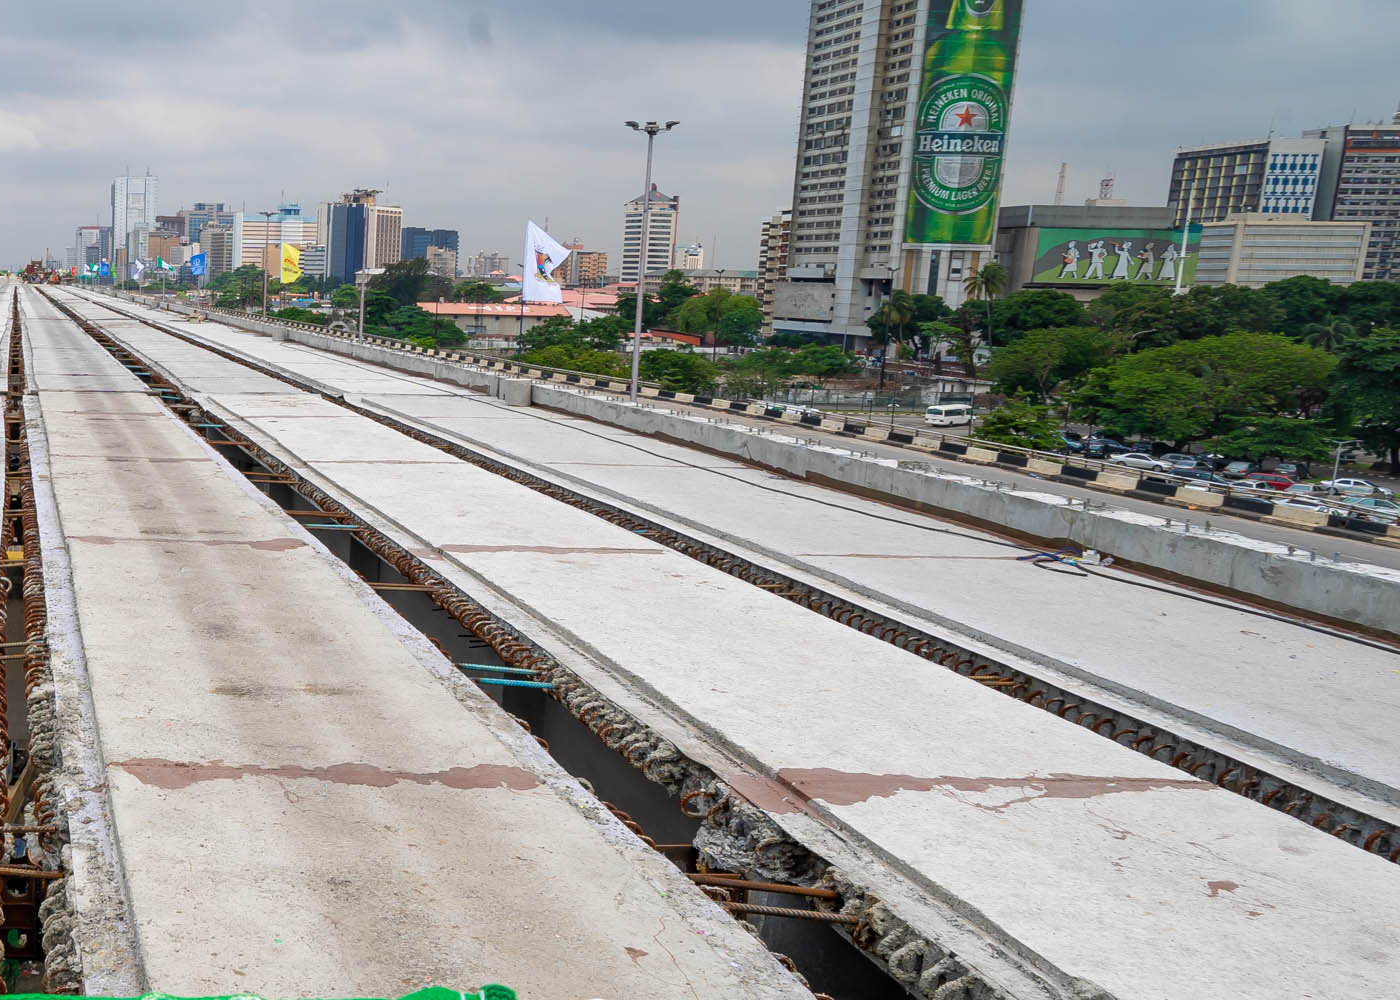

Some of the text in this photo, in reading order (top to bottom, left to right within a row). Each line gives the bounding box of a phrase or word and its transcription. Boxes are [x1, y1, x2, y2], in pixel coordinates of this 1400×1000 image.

[928, 88, 999, 124] HEINEKEN ORIGINAL
[918, 134, 999, 153] Heineken
[921, 167, 950, 200] PREMIUM
[951, 189, 978, 201] LAGER
